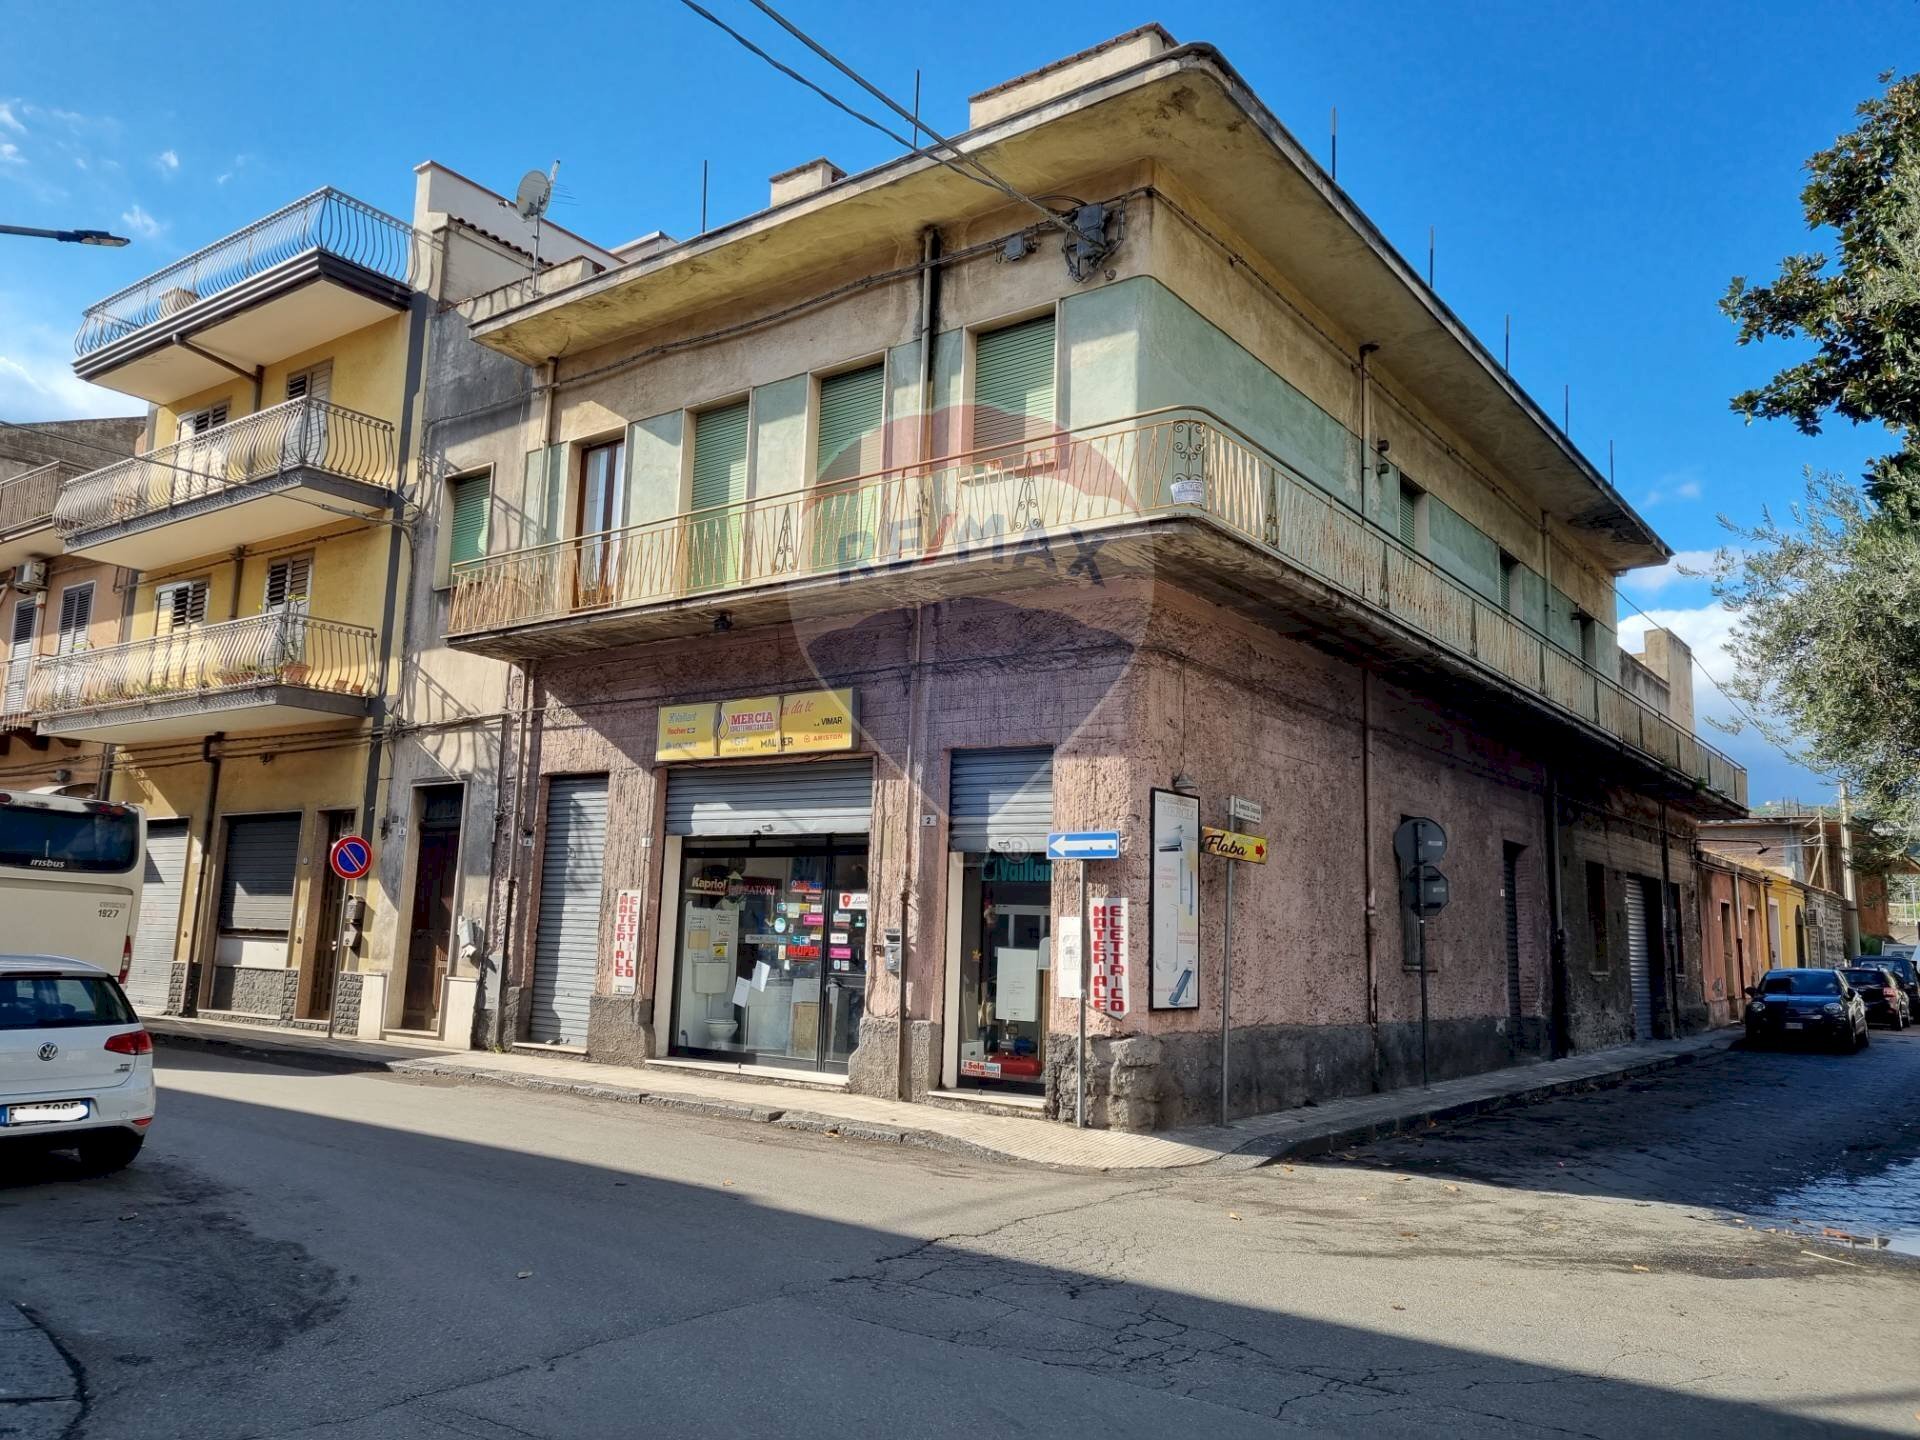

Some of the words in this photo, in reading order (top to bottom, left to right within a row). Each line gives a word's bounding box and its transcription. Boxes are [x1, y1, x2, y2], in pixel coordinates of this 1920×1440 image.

[730, 712, 774, 725] MERCIA
[821, 716, 843, 726] VIMAR
[1205, 833, 1247, 856] Flaba
[30, 859, 65, 868] irisbus
[1000, 857, 1051, 882] Vaillan
[615, 895, 628, 977] MATERIALE
[1093, 906, 1107, 1012] MATERIALE
[1109, 906, 1124, 1011] ELETTRICO
